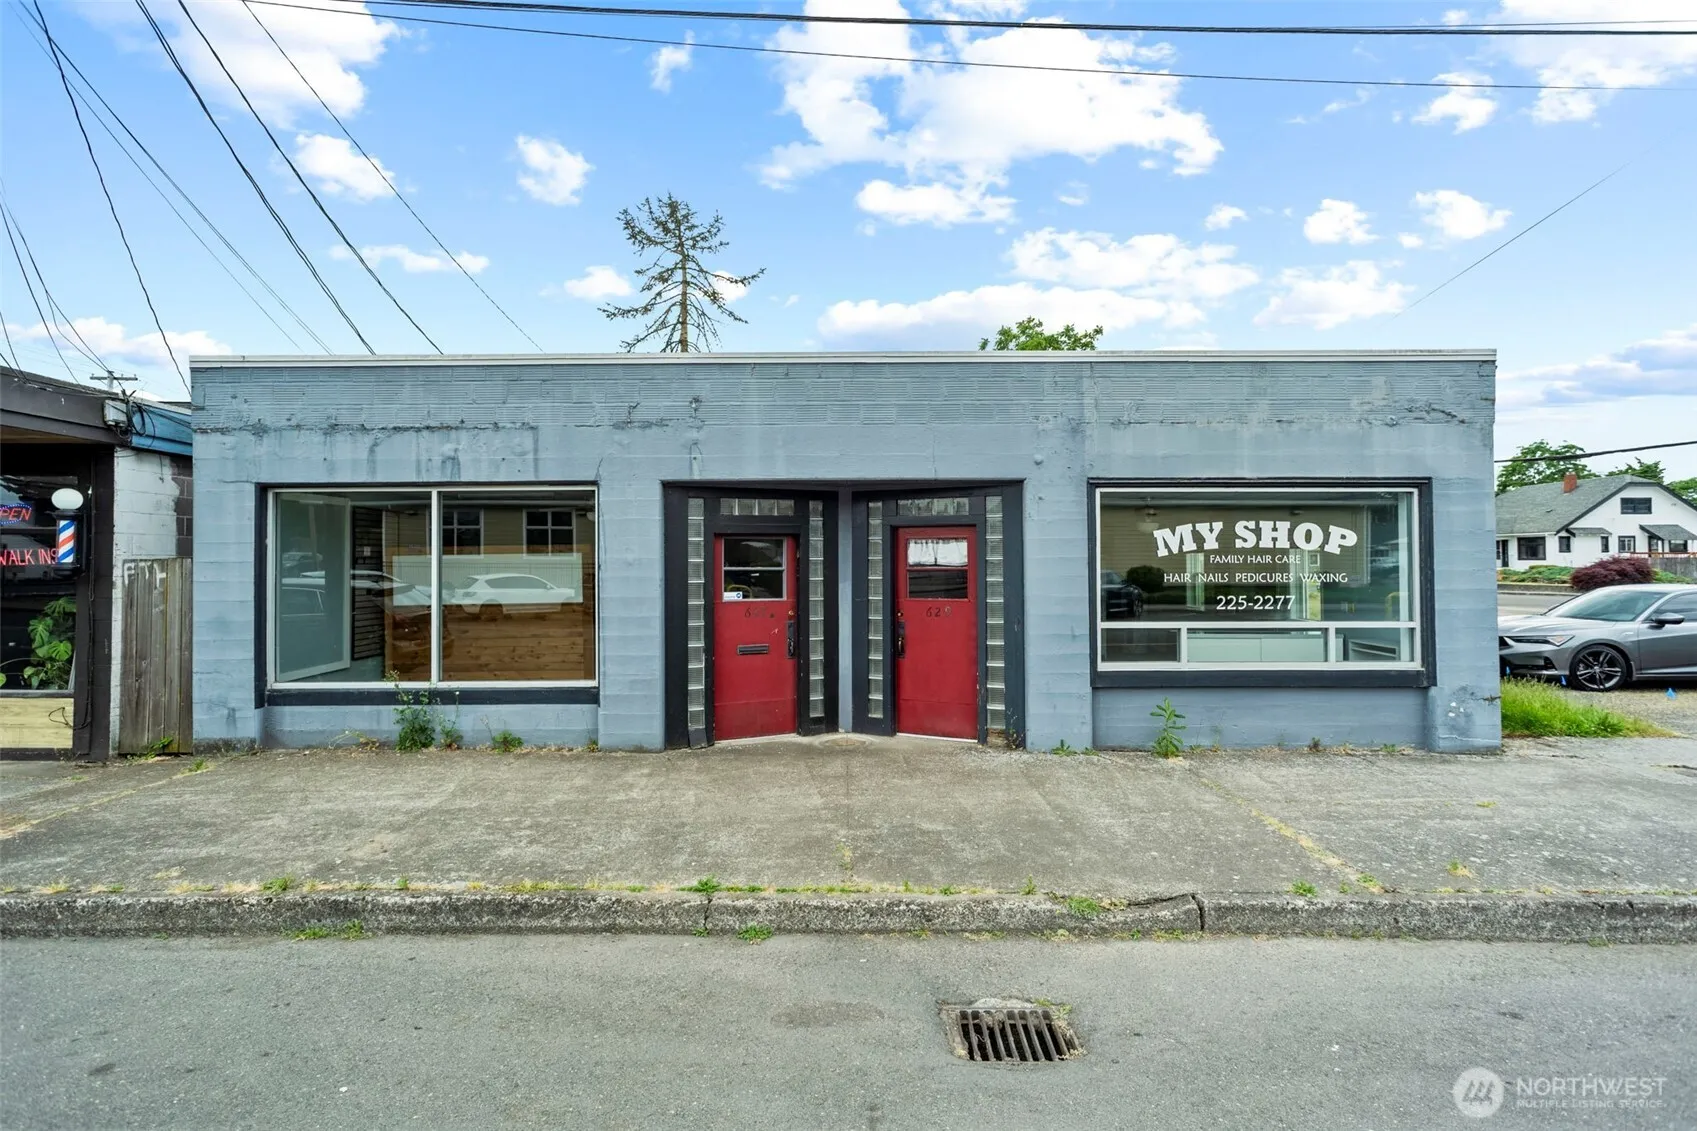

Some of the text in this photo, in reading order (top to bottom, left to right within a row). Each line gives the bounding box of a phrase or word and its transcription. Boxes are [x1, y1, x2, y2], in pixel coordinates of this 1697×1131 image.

[0, 508, 32, 521] PEN
[1153, 520, 1358, 557] MY SHOP
[1209, 554, 1301, 564] FAMILY HAIR CARE
[1164, 572, 1348, 583] HAIR NAILS PEDICURES WAXING
[1216, 595, 1296, 610] 225-2277
